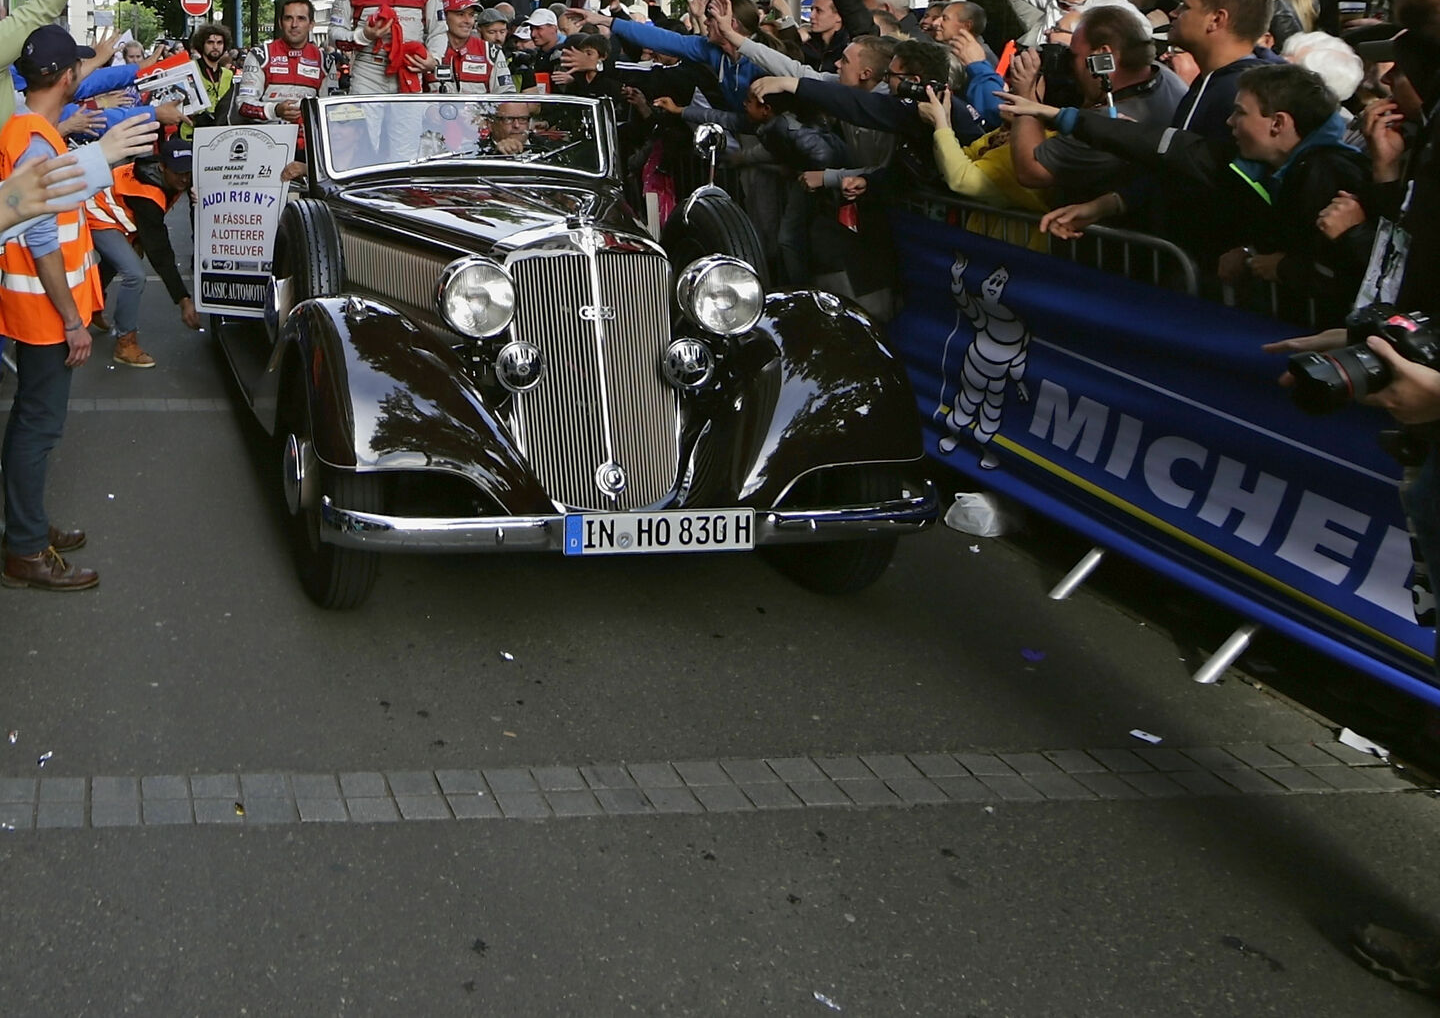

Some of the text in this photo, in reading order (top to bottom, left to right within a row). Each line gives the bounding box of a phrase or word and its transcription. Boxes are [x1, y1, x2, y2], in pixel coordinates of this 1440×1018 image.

[202, 192, 226, 210] AUDI
[229, 190, 251, 203] R18
[211, 229, 265, 241] A.LOTTERER
[211, 244, 264, 257] B.TRELUYER
[202, 281, 228, 300] CLASSIC
[584, 514, 752, 549] IN HO 830 H
